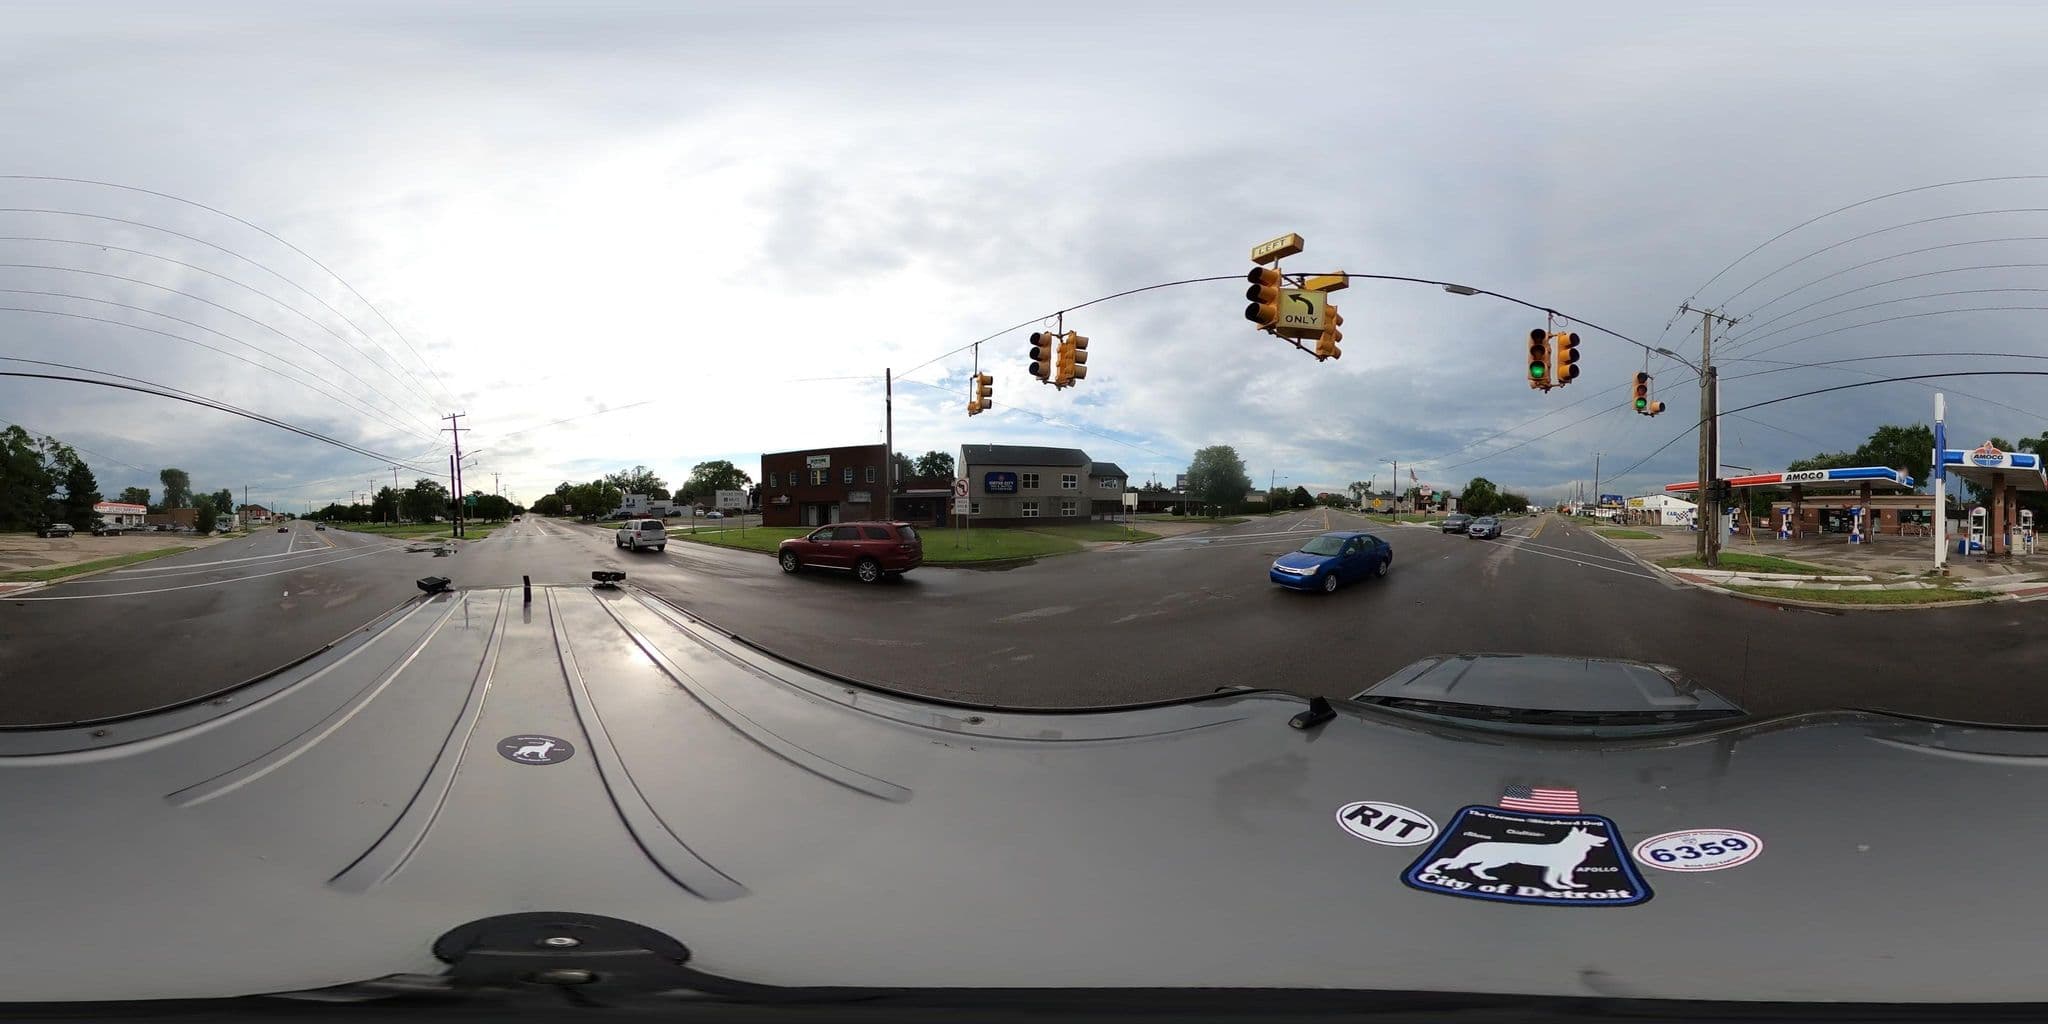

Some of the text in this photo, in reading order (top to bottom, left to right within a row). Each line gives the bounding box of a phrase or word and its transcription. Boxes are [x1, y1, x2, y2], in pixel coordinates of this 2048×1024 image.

[1258, 239, 1287, 255] LEFT
[1285, 314, 1318, 324] ONLY
[1785, 471, 1824, 481] AMOCO
[1344, 805, 1428, 838] RIT
[1650, 838, 1748, 862] 6359
[1417, 873, 1633, 899] City of Detroit
